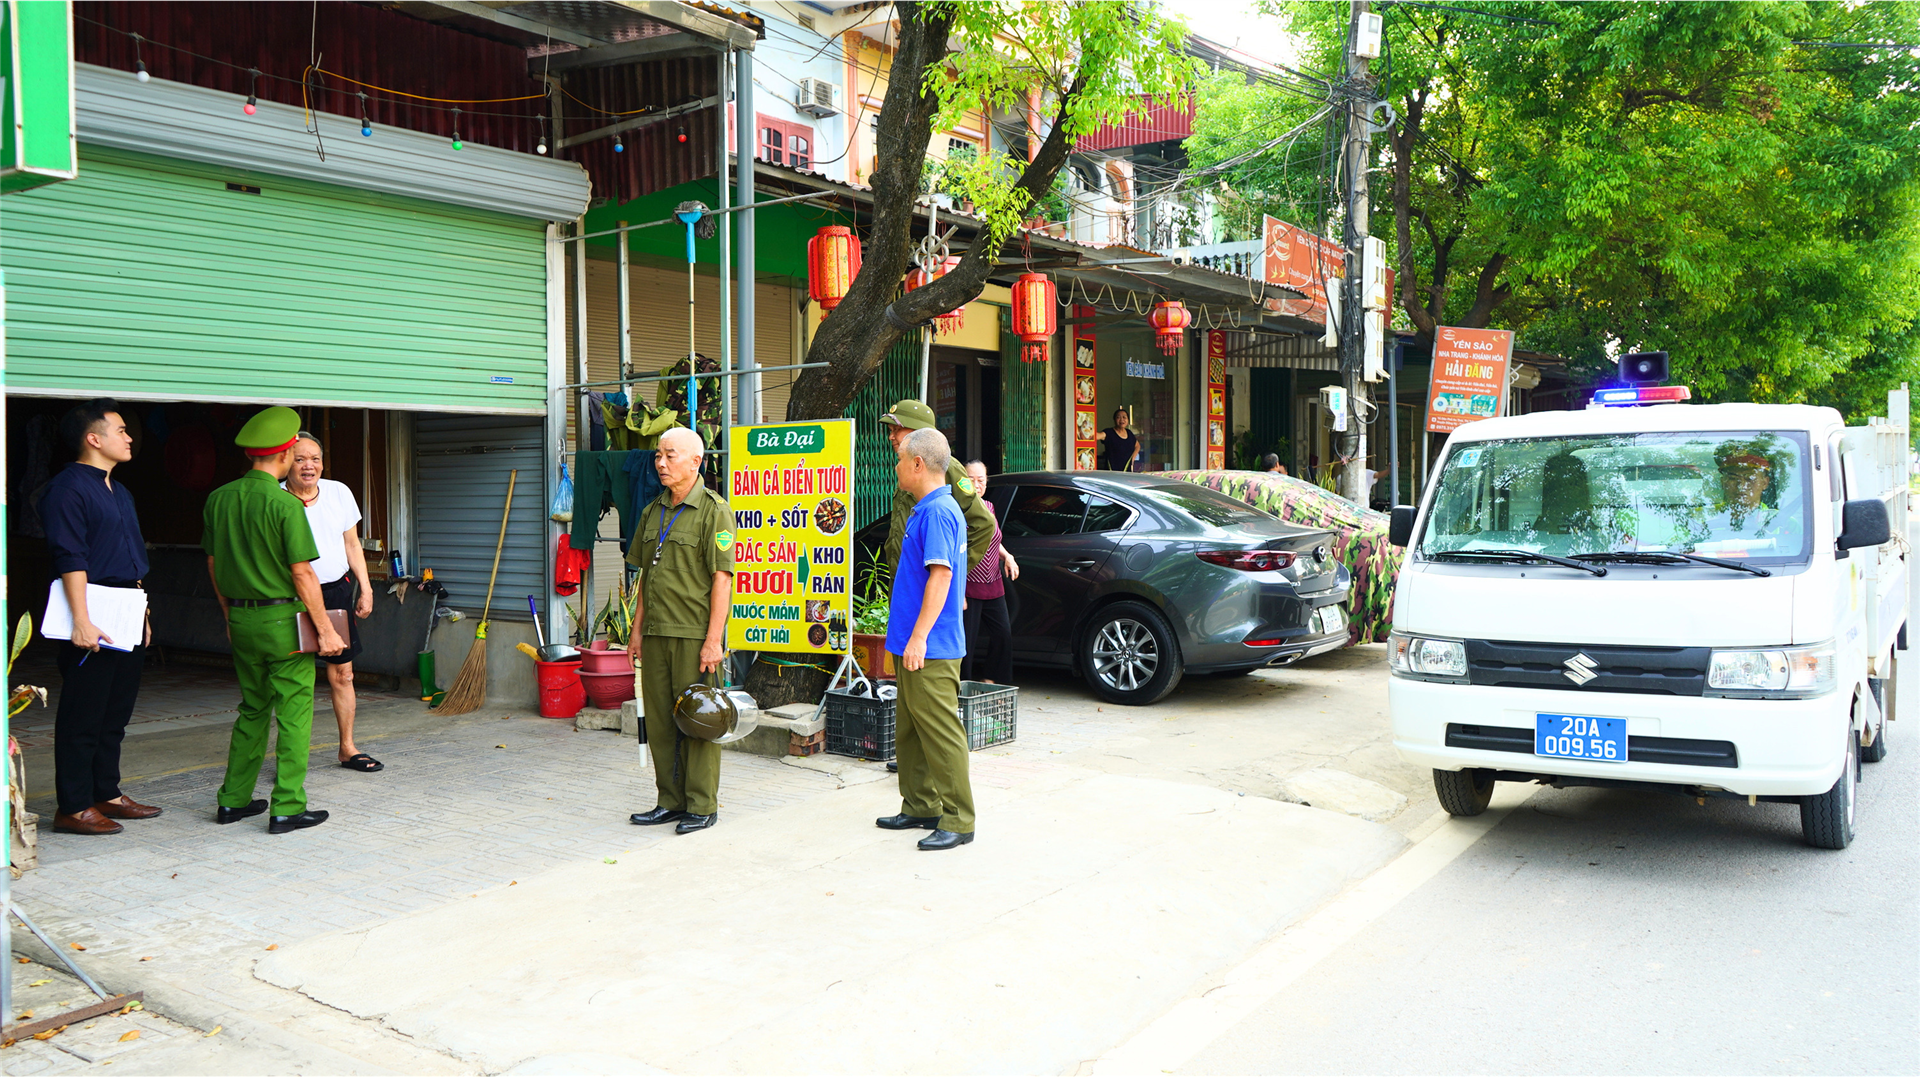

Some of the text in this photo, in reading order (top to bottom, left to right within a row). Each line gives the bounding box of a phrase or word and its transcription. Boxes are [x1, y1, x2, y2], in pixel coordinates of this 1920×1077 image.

[1438, 350, 1450, 358] NHA
[1450, 351, 1469, 360] TRANG
[1472, 341, 1494, 351] SÀO
[1445, 360, 1494, 379] HẢI ĐĂNG
[756, 430, 815, 449] Bà Đại
[733, 458, 846, 496] BÁN CÁ BIỂN TƯƠI
[735, 510, 763, 529] KHO
[781, 502, 809, 528] SỐT
[735, 535, 797, 567] ĐẶC SẢN
[813, 547, 845, 564] KHO
[736, 570, 794, 595] RƯƠI
[812, 573, 845, 594] RÁN
[732, 600, 800, 621] NƯỚC MẮM
[745, 625, 790, 644] CÁT HẢI
[1561, 717, 1600, 737] 20A
[1545, 736, 1617, 758] 009.56
